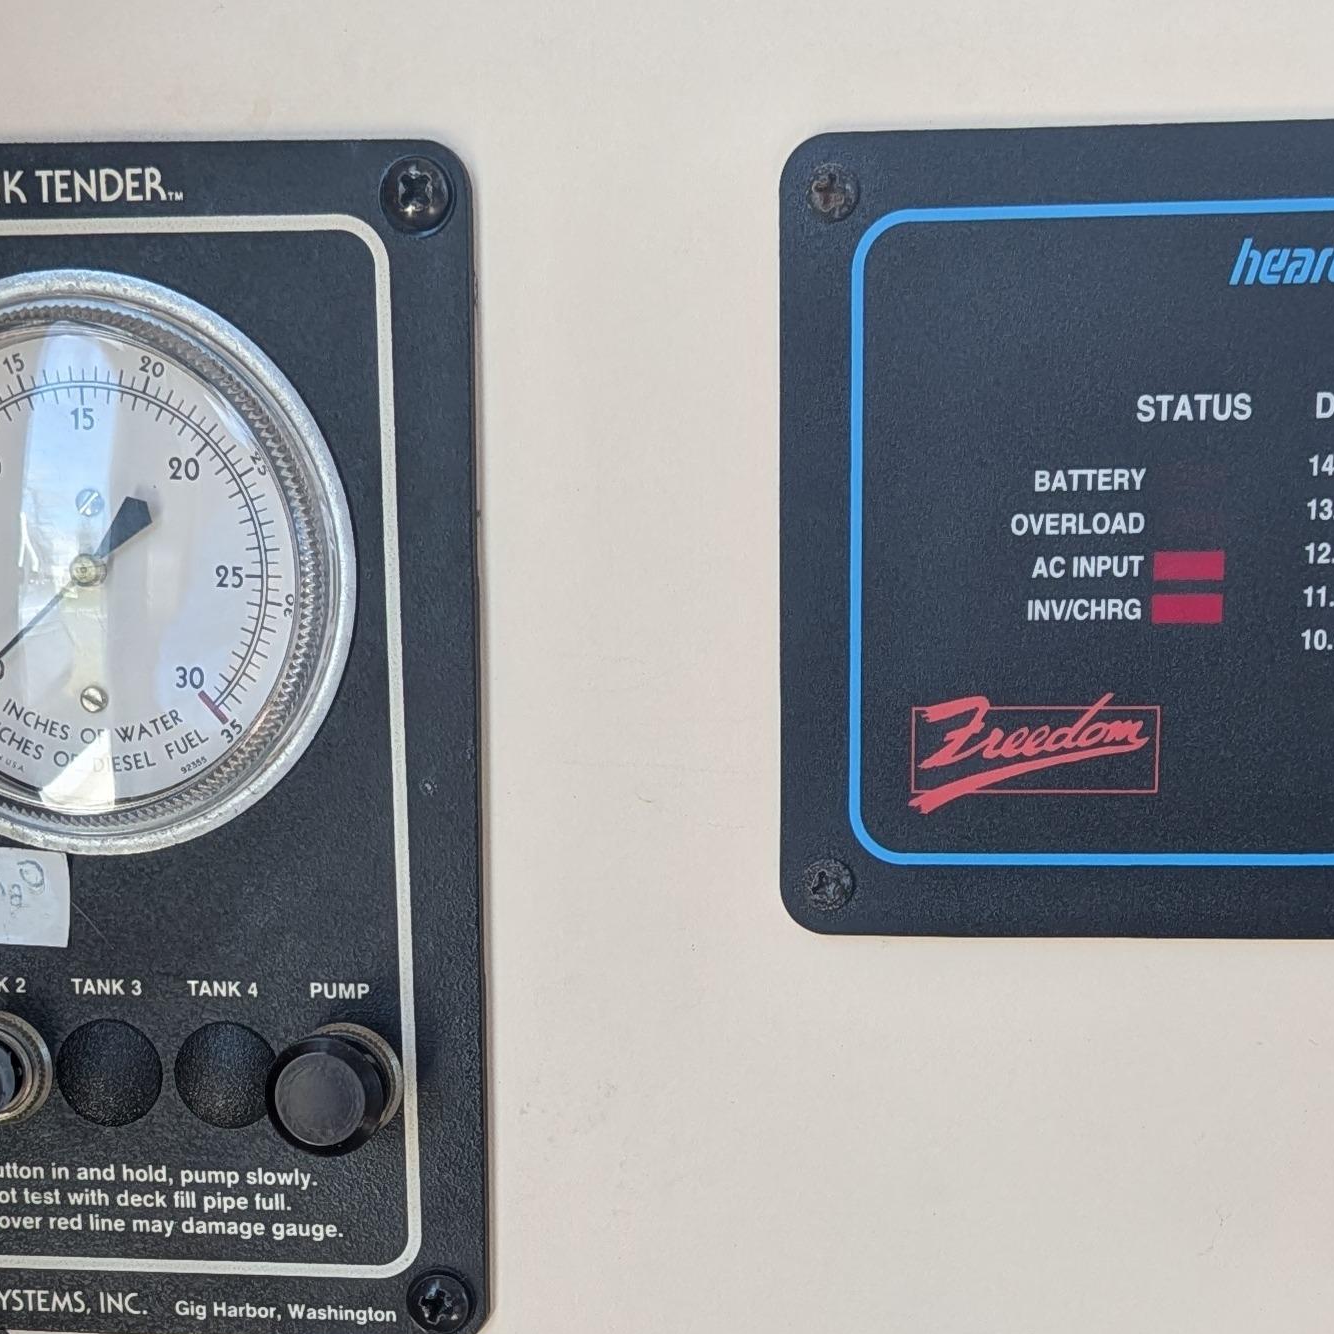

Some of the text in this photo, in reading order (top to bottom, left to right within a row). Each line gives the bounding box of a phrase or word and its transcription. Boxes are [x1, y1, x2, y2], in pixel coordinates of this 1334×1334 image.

[34, 166, 167, 204] TENDER
[2, 353, 26, 375] 15
[139, 355, 165, 378] 20
[70, 407, 95, 431] 15
[1136, 392, 1252, 423] STATUS
[168, 457, 200, 481] 20
[1034, 468, 1147, 492] BATTERY
[1010, 512, 1145, 536] OVERLOAD
[215, 565, 244, 589] 25
[1031, 555, 1145, 579] AC INPUT
[1027, 598, 1142, 621] INV/CHRG
[175, 666, 205, 689] 30
[2, 698, 71, 741] INCHES
[115, 709, 184, 744] WATER
[220, 719, 243, 744] 35
[918, 692, 1151, 770] Freedom
[92, 751, 157, 774] DIESEL
[164, 729, 209, 760] FUEL
[15, 977, 27, 993] 2
[70, 978, 143, 996] TANK 3
[186, 980, 259, 998] TANK 4
[309, 982, 370, 1000] PUMP
[51, 1162, 70, 1181] in
[76, 1164, 116, 1182] and
[122, 1163, 174, 1186] hold,
[180, 1169, 240, 1188] pump
[246, 1167, 318, 1190] slowly.
[23, 1187, 61, 1205] test
[67, 1189, 110, 1207] with
[116, 1190, 167, 1208] deck
[173, 1190, 197, 1209] fill
[203, 1192, 249, 1213] pipe
[254, 1193, 292, 1211] full.
[49, 1213, 83, 1231] red
[89, 1213, 126, 1232] line
[132, 1218, 175, 1238] may
[181, 1216, 265, 1239] damage
[271, 1221, 344, 1242] gauge.
[99, 1291, 148, 1316] INC.
[175, 1300, 397, 1326] Gig Harbor, Washington
